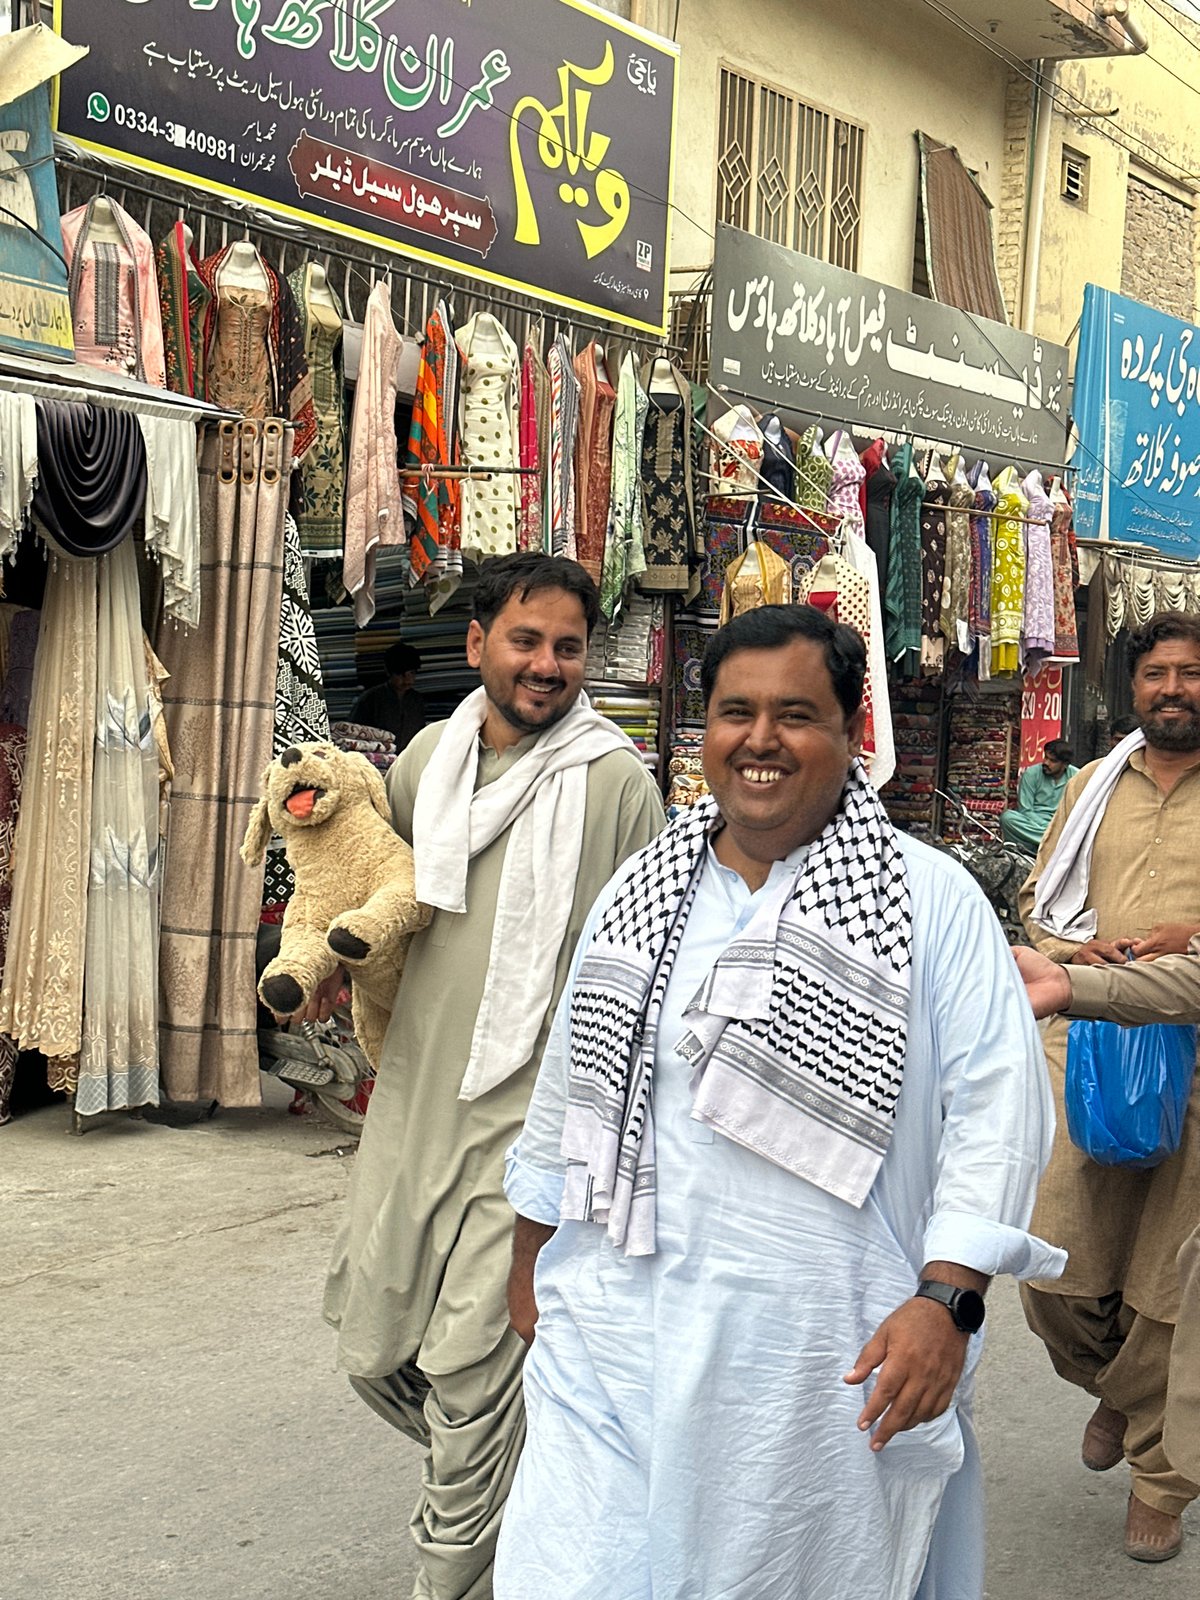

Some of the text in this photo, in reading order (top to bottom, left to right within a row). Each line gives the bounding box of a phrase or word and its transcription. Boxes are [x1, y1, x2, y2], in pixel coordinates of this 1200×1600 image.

[143, 41, 166, 66] ہے
[167, 49, 213, 79] دستیاب
[212, 67, 224, 92] پر
[226, 70, 258, 93] ریٹ
[258, 72, 283, 102] سیل
[382, 33, 511, 138] عمران
[279, 81, 304, 111] ہول
[114, 104, 236, 163] 0334-340981
[335, 107, 357, 136] تمام
[356, 108, 372, 139] کی
[240, 152, 267, 171] عمران
[409, 137, 431, 164] موسم
[430, 147, 446, 173] ہاں
[509, 39, 631, 260] ویلکم
[309, 154, 352, 191] ڈیلر
[448, 155, 482, 179] ہمارے
[352, 167, 403, 204] سیل
[440, 205, 482, 237] سپر
[638, 242, 650, 258] ZP
[775, 281, 826, 344] کلاتھ
[844, 288, 886, 367] فیصل
[813, 295, 852, 366] آباد
[761, 360, 775, 384] ہیں
[774, 363, 800, 388] دستیاب
[799, 372, 818, 389] سوٹ
[815, 368, 828, 392] کے
[1121, 332, 1165, 409] پردہ
[847, 377, 858, 400] کے
[857, 374, 870, 411] قسم
[1045, 369, 1062, 414] نیو
[1121, 423, 1173, 488] کلاتھ
